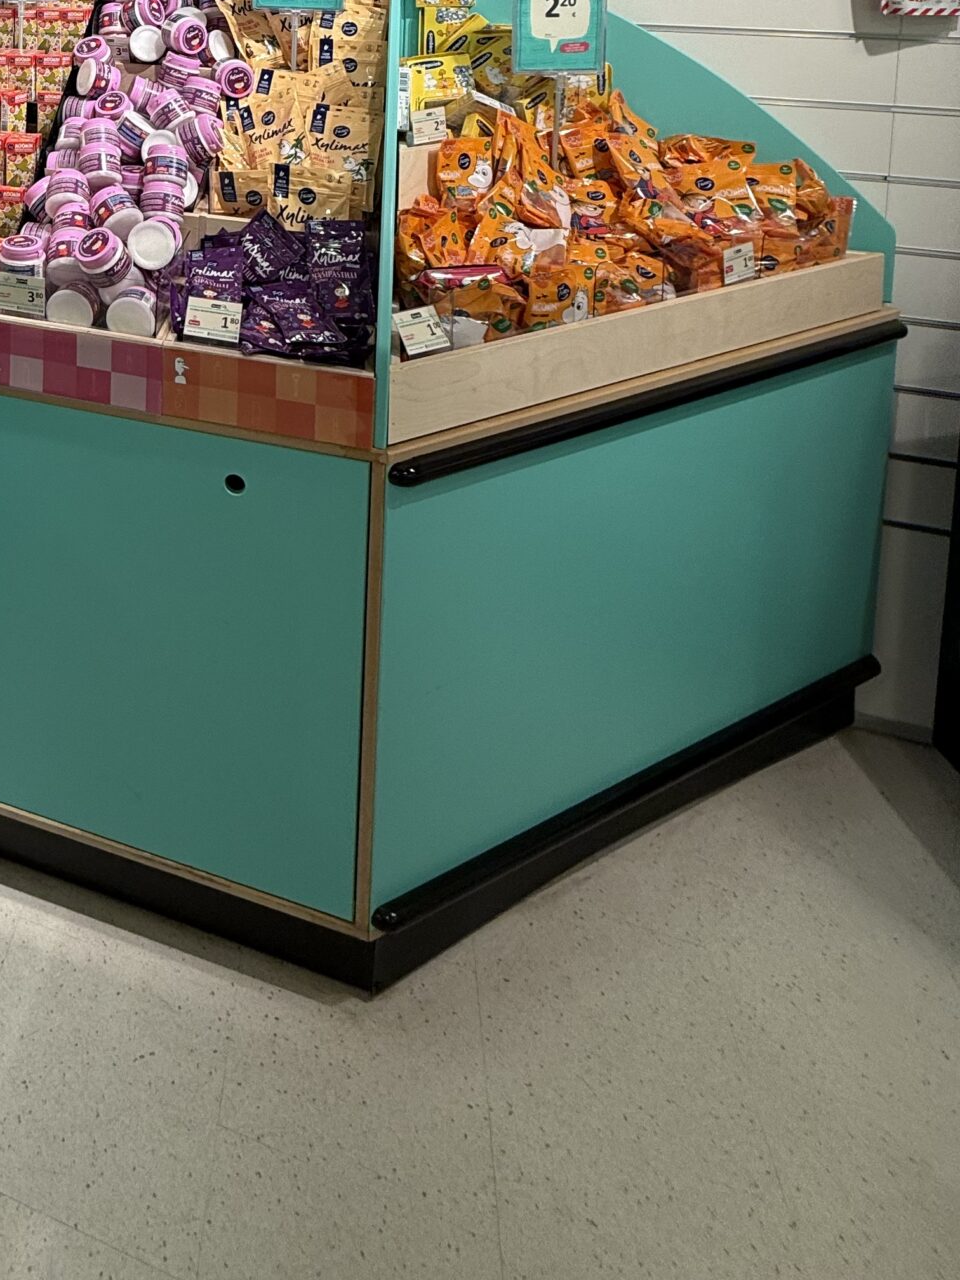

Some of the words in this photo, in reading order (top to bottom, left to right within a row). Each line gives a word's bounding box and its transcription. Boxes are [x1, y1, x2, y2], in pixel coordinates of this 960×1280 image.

[231, 0, 252, 16] Xyli
[248, 119, 294, 146] Xylimax
[312, 137, 369, 153] Xylimax
[312, 250, 361, 266] Xylimax
